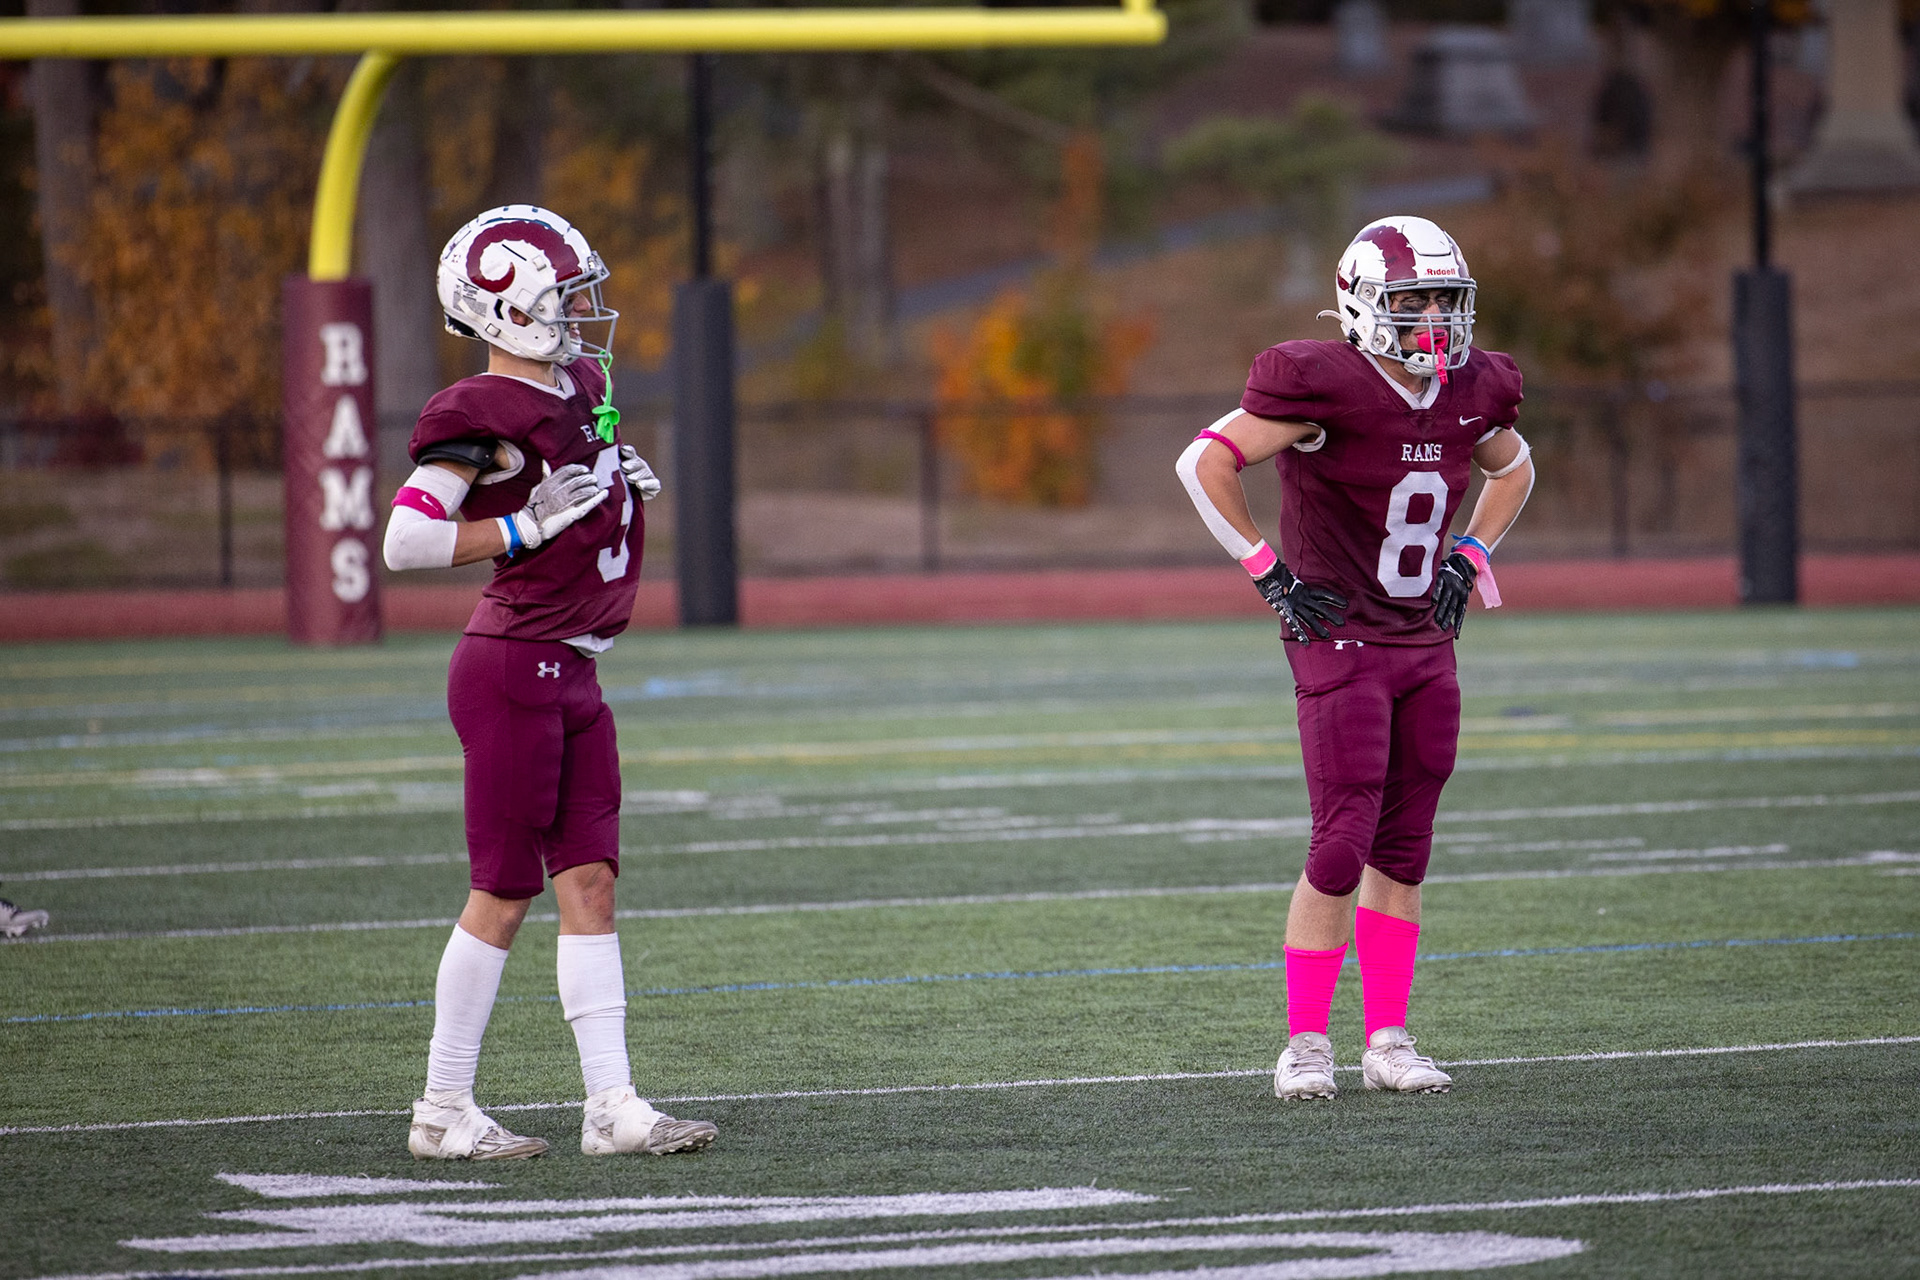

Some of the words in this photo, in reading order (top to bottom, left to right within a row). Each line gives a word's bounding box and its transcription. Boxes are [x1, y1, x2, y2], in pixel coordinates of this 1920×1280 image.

[319, 322, 374, 603] RAMS
[592, 444, 634, 583] 3
[1401, 443, 1442, 462] RAMS
[1376, 471, 1450, 598] 8
